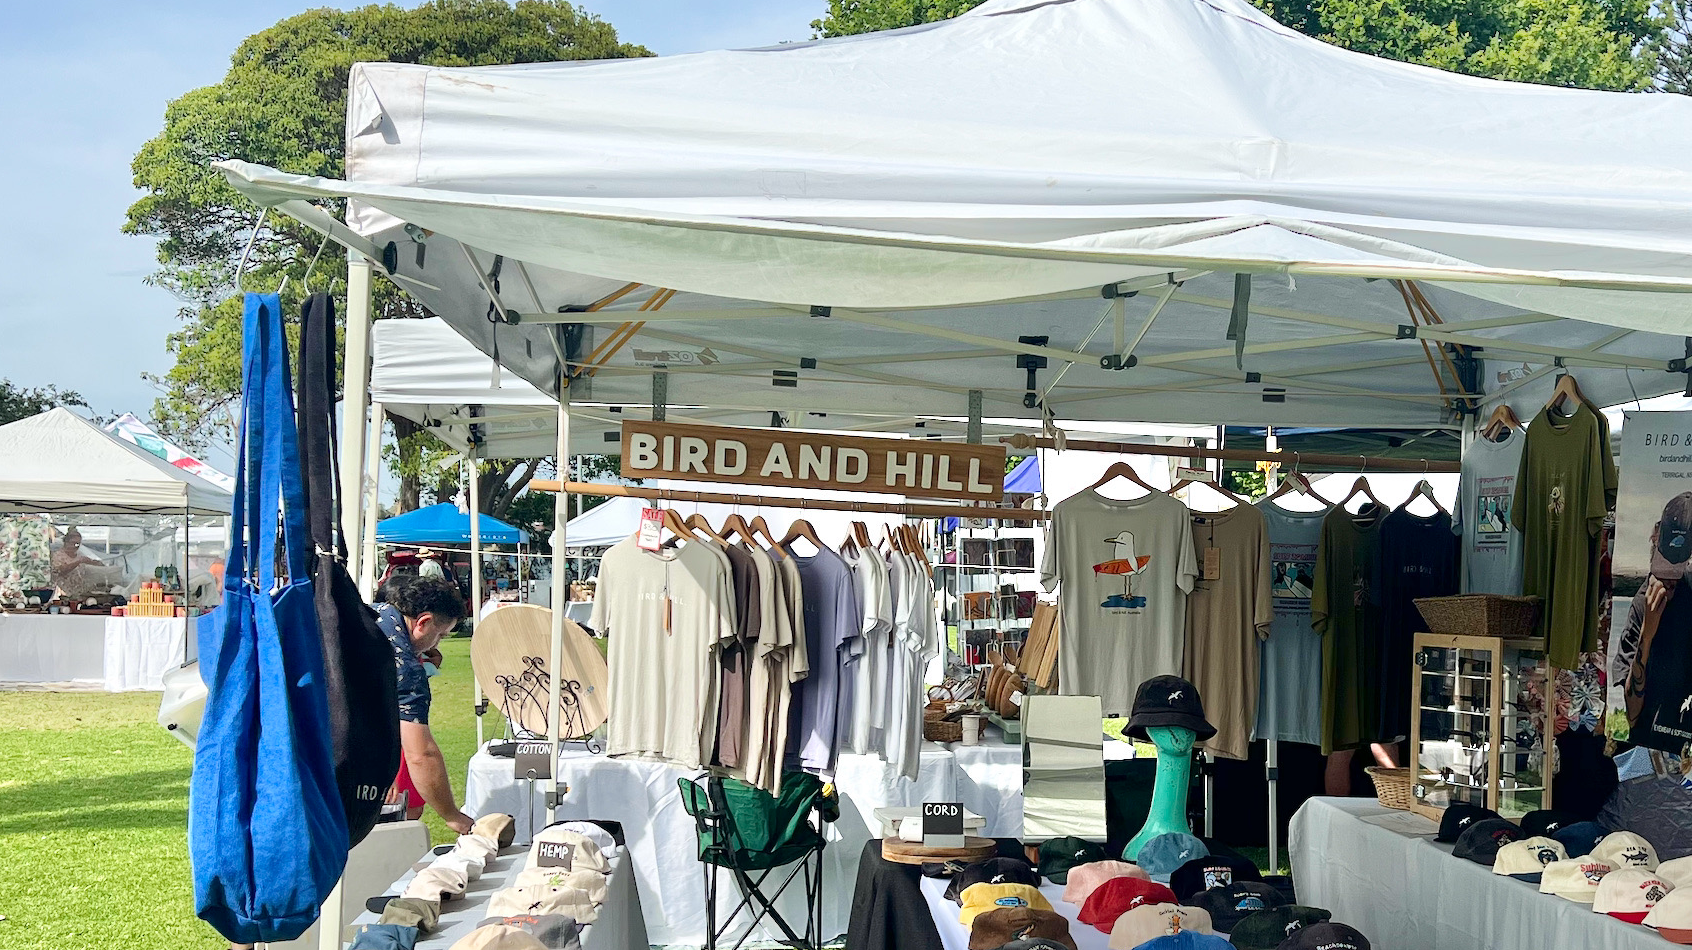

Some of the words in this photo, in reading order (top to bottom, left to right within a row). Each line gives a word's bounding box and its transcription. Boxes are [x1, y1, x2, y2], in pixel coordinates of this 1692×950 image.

[1645, 433, 1680, 447] BIRD
[629, 432, 747, 476] BIRD
[760, 442, 869, 483] AND
[886, 450, 994, 494] HILL
[516, 743, 552, 755] COTTON
[924, 803, 959, 817] CORD
[539, 843, 569, 860] HEMP
